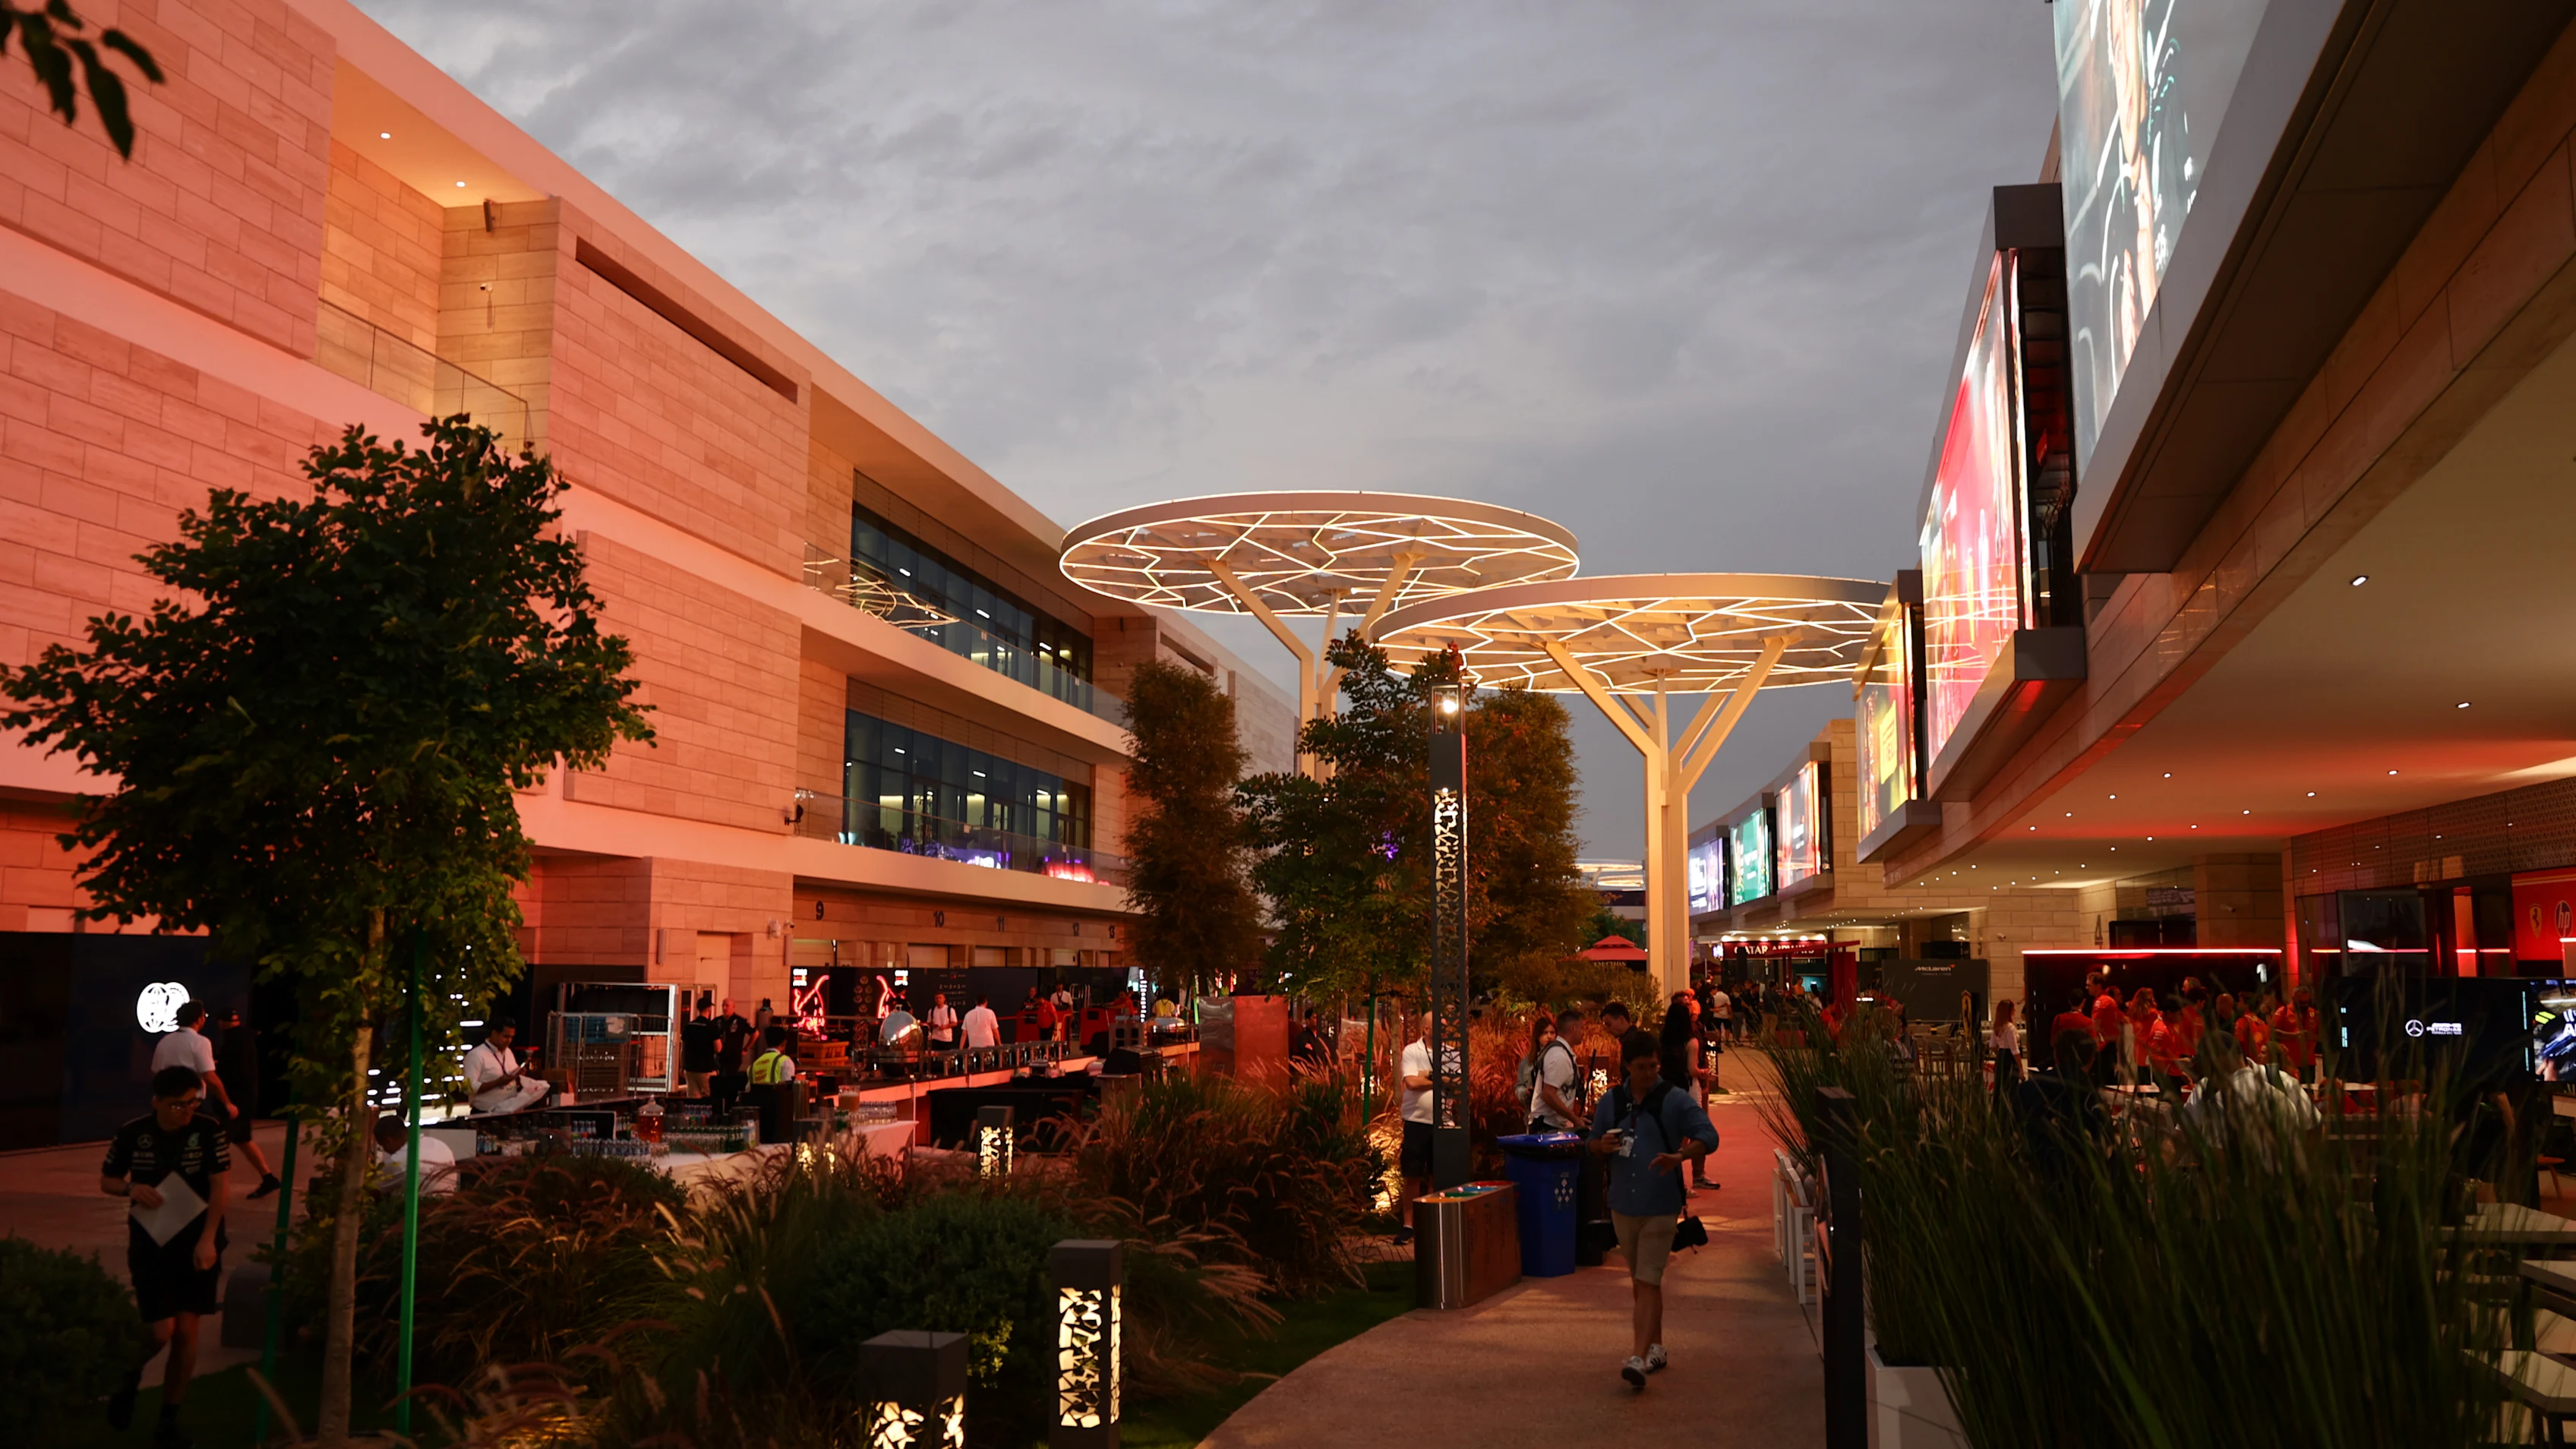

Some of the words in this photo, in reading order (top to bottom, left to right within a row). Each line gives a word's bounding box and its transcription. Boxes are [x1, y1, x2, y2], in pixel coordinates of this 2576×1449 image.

[816, 901, 824, 920] 9
[933, 911, 944, 927] 10
[997, 916, 1005, 932] 11
[1072, 922, 1079, 936] 12
[1108, 925, 1115, 939] 13
